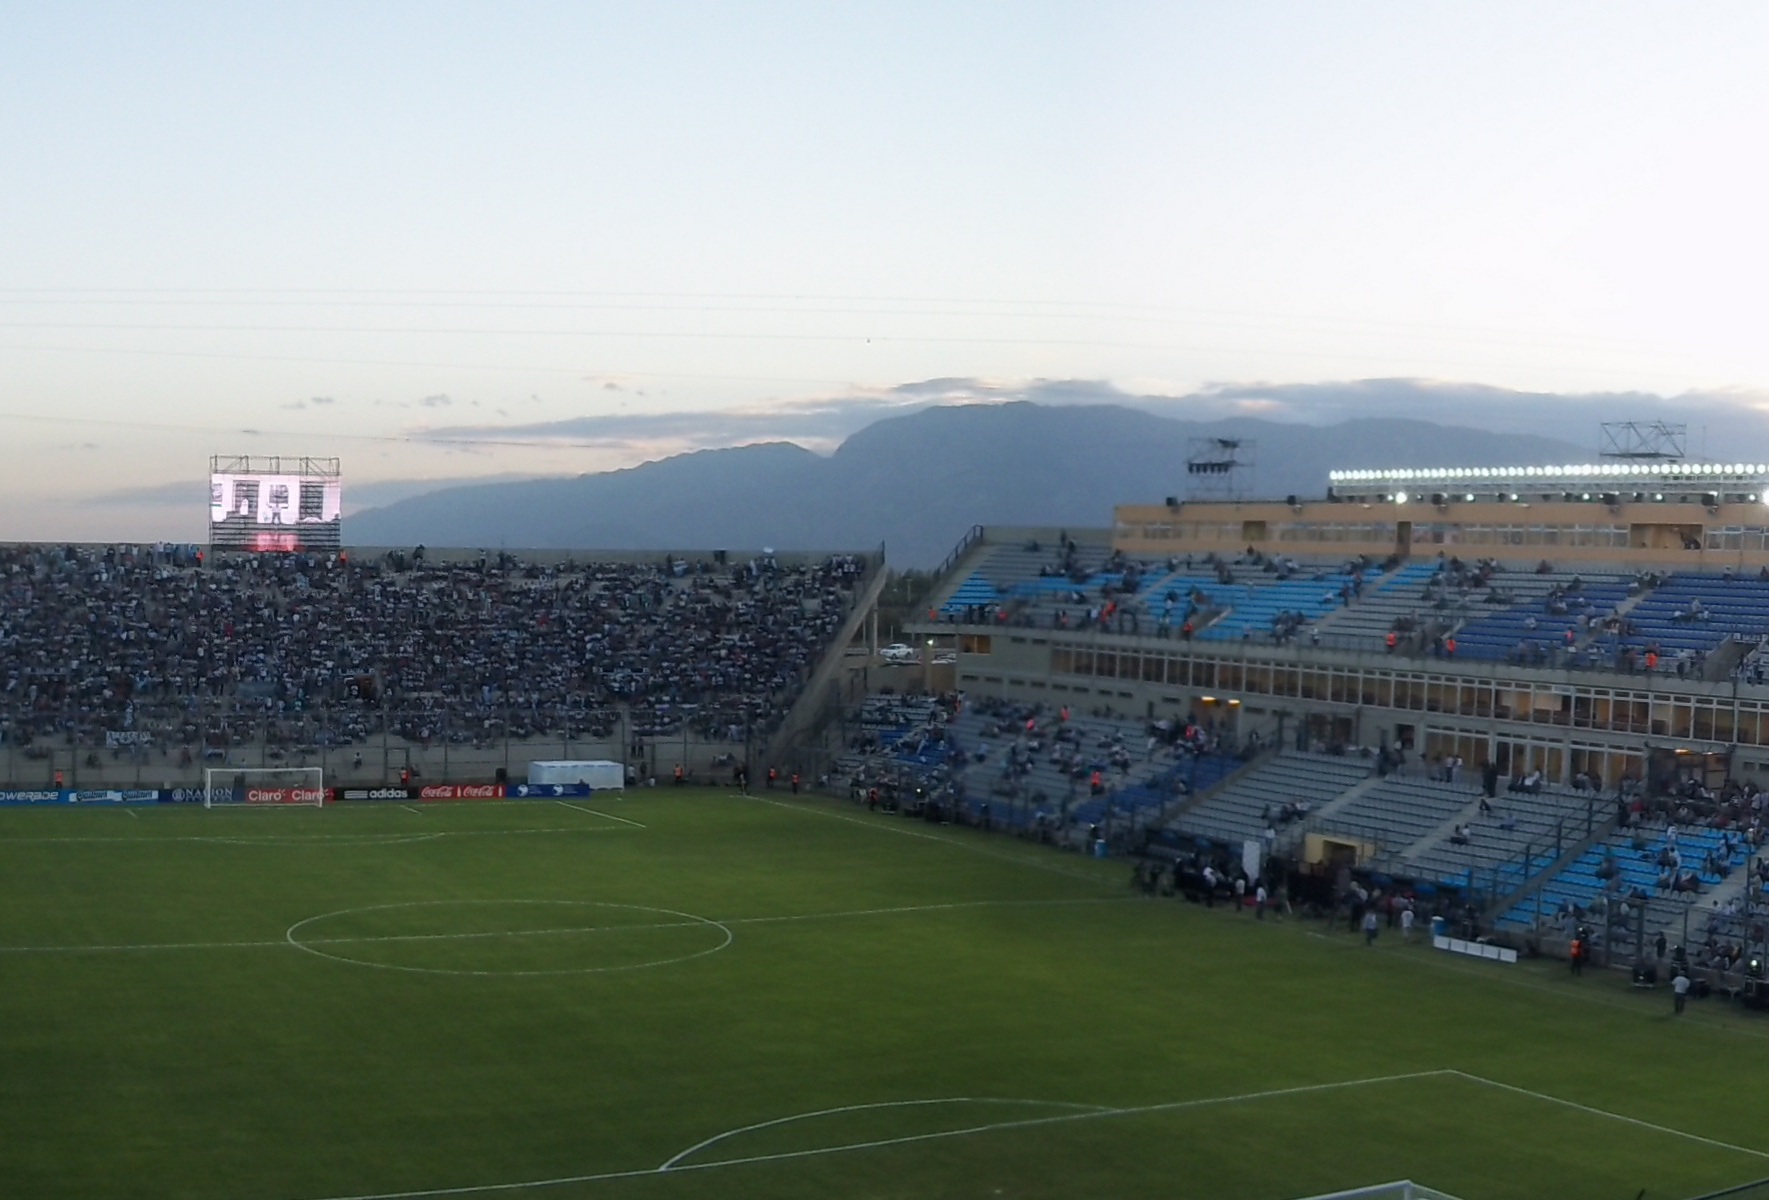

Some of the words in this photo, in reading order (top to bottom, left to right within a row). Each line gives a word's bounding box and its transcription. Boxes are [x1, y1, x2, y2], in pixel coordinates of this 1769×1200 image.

[248, 790, 282, 801] Claro
[291, 790, 325, 801] Claro
[369, 788, 408, 798] adidas
[421, 785, 453, 798] Coca-Cola
[463, 785, 494, 797] Coca-Cola
